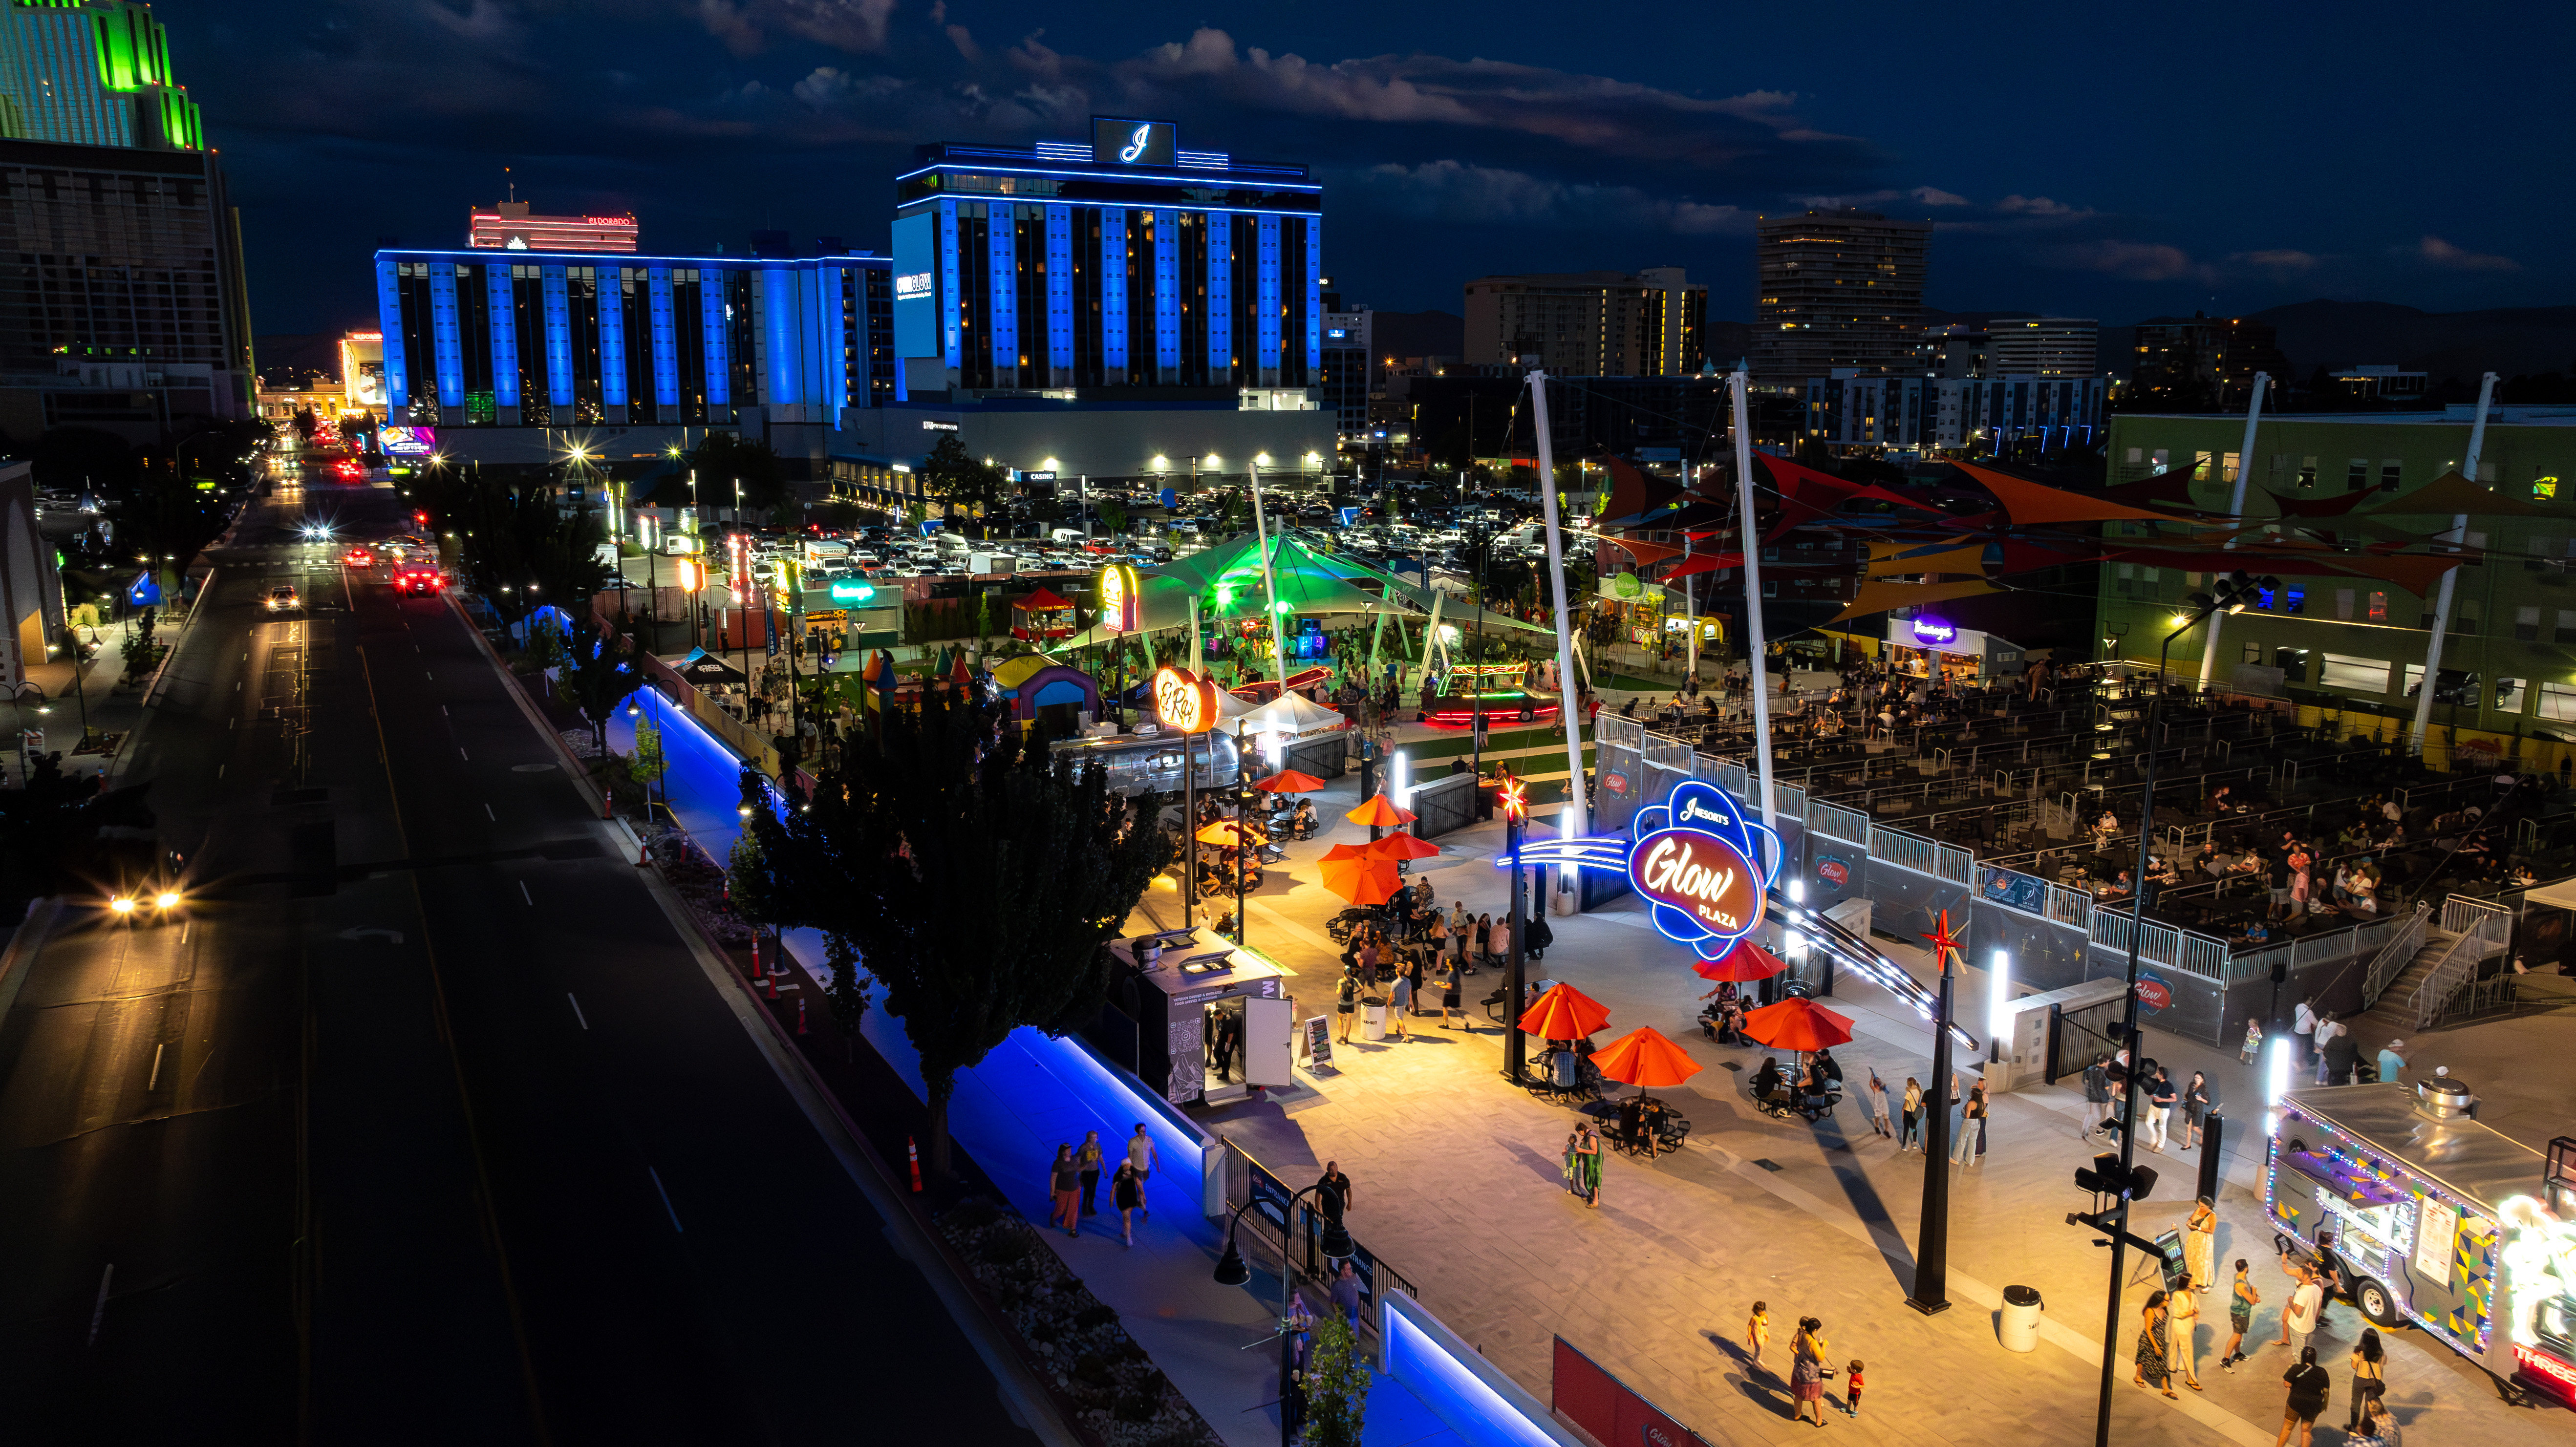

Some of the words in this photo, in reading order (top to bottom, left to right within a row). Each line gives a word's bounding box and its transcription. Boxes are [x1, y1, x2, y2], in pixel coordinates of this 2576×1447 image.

[1606, 776, 1622, 787] Glow
[1644, 837, 1734, 902] Glow
[1820, 863, 1842, 878] Glow
[1698, 904, 1738, 930] PLAZA
[2134, 982, 2162, 1000] Glow
[1265, 1183, 1289, 1207] ENTRANCE
[1350, 1254, 1373, 1277] TRANCE
